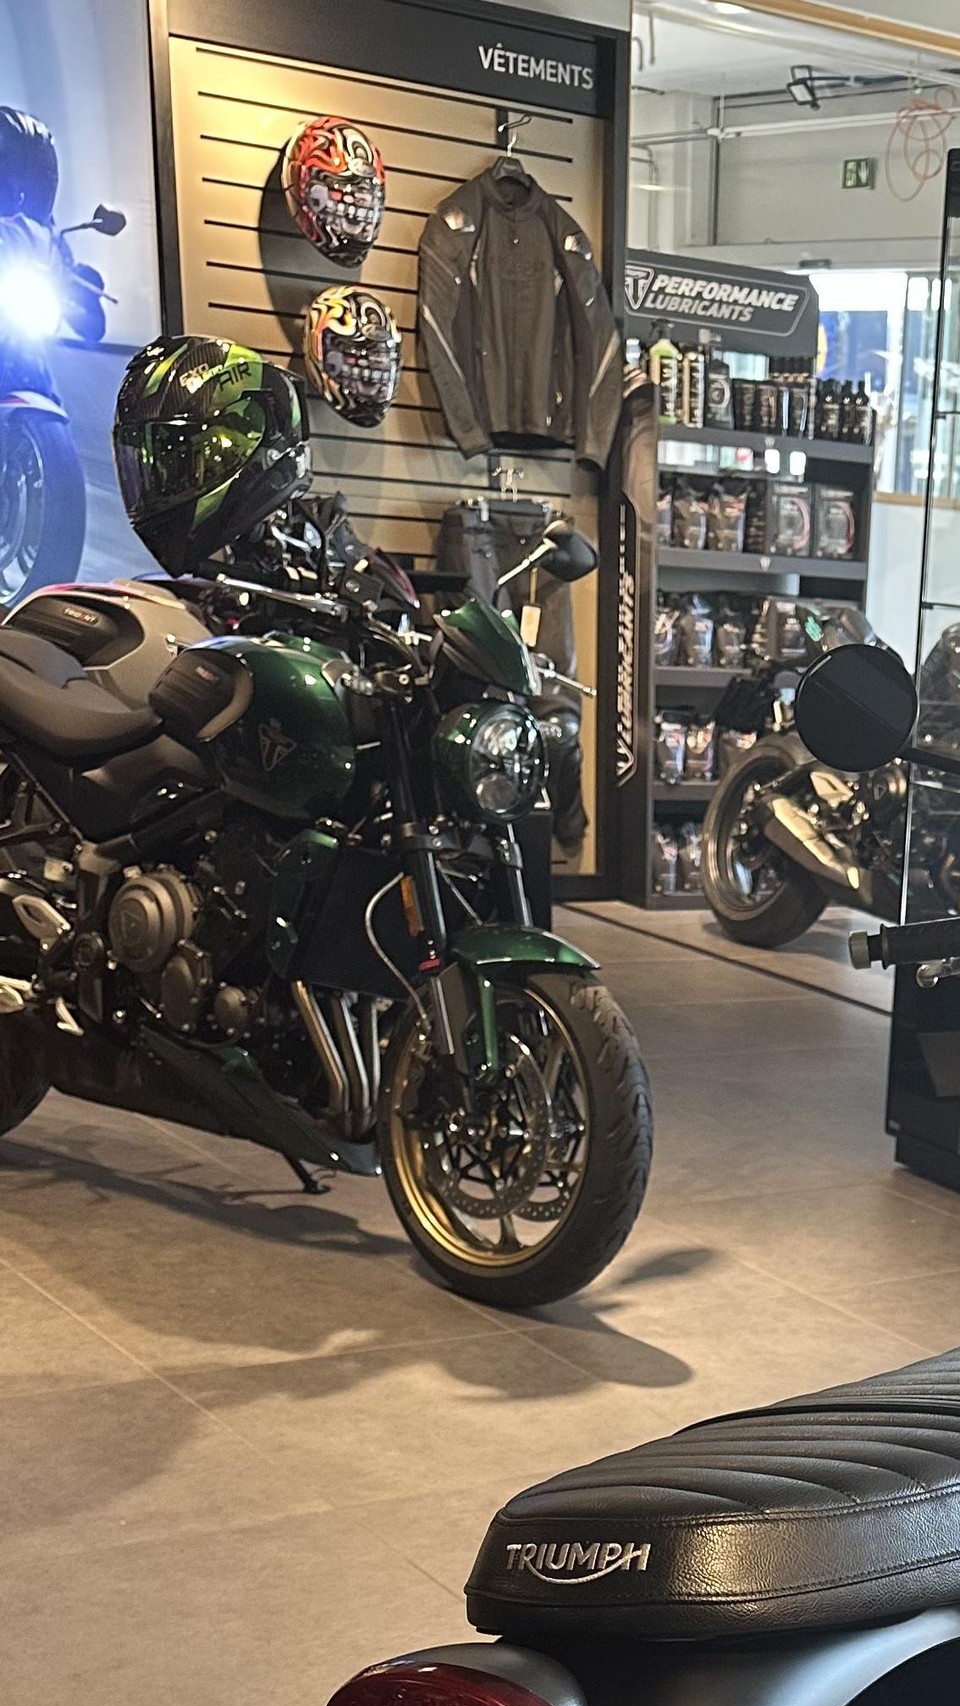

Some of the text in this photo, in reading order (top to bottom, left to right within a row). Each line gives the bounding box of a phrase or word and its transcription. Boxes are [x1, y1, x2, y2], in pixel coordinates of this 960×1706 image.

[478, 43, 594, 89] VÊTEMENTS
[644, 293, 753, 322] LUBRICANTS
[652, 274, 799, 311] PERFORMANCE
[506, 1542, 651, 1585] TRIUMPH
